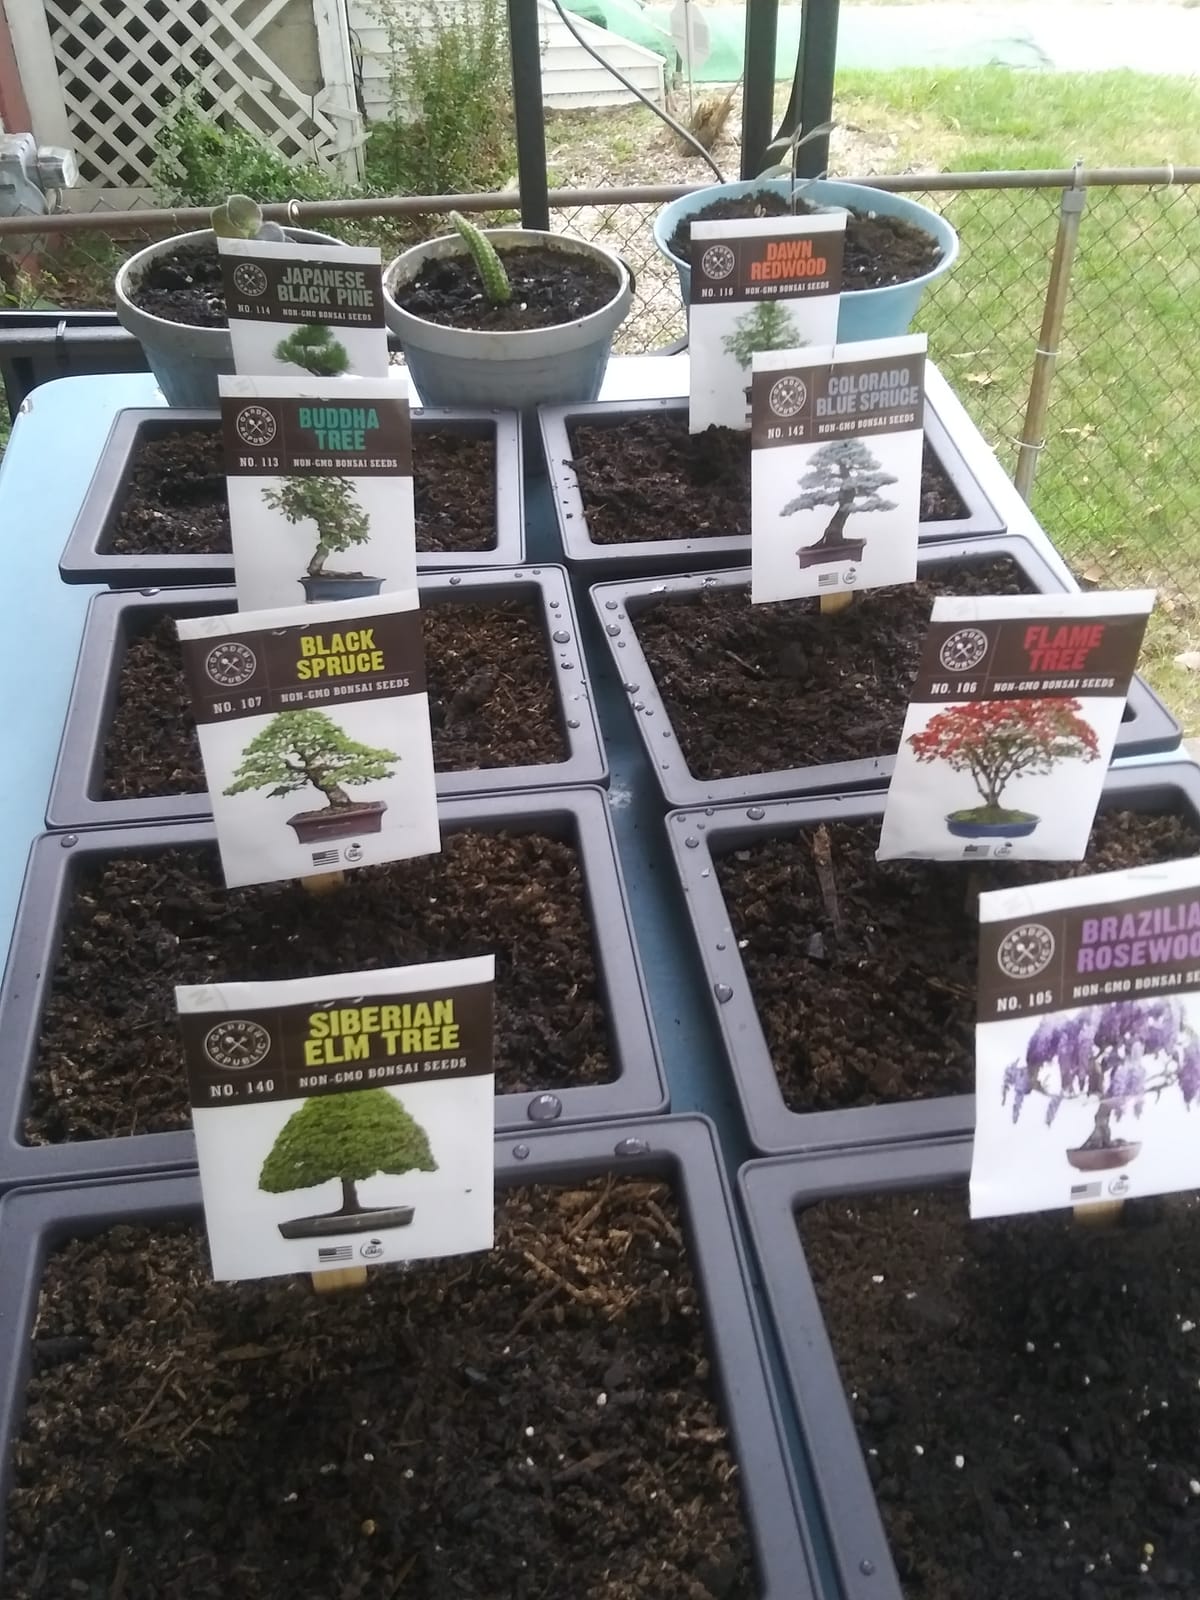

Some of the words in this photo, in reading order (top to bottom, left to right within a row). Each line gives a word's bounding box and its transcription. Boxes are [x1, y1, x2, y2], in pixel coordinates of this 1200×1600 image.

[767, 240, 813, 260] DAWN
[282, 267, 366, 289] JAPANESE
[751, 257, 826, 280] REDWOOD
[277, 284, 331, 304] BLACK
[337, 289, 374, 307] PINE
[702, 289, 716, 297] NO.
[720, 287, 733, 296] 116
[745, 285, 777, 295] NON-GMO
[780, 284, 805, 292] BONSAI
[807, 281, 829, 291] SEEDS
[238, 304, 252, 313] NO.
[257, 305, 270, 314] 114
[283, 308, 316, 318] NON-GMO
[319, 311, 346, 319] BONSAI
[349, 313, 372, 321] SEEDS
[828, 368, 909, 395] COLORADO
[817, 396, 857, 416] BLUE
[860, 386, 919, 410] SPRUCE
[240, 408, 270, 422] GARDEN
[299, 407, 379, 429] BUDDHA
[819, 421, 855, 433] NON-GMO
[858, 416, 887, 429] BONSAI
[889, 413, 915, 424] SEEDS
[240, 426, 273, 443] REPUBLIC
[315, 430, 366, 450] TREE
[768, 428, 783, 439] NO.
[788, 426, 804, 436] 142
[240, 458, 257, 467] NO.
[262, 457, 279, 467] 113
[293, 459, 333, 467] NON-GMO
[336, 459, 368, 468] BONSAI
[370, 459, 397, 468] SEEDS
[300, 629, 377, 657] BLACK
[948, 632, 983, 647] GARDEN
[1024, 624, 1105, 650] FLAME
[211, 646, 250, 663] GARDEN
[944, 650, 983, 669] REPUBLIC
[1029, 650, 1088, 672] TREE
[211, 662, 253, 683] REPUBLIC
[296, 651, 385, 680] SPRUCE
[281, 689, 331, 703] NON-GMO
[333, 683, 373, 696] BONSAI
[376, 678, 410, 691] SEEDS
[930, 683, 951, 694] NO.
[993, 681, 1039, 692] NON-GMO
[1042, 680, 1079, 689] BONSAI
[1082, 678, 1115, 689] SEEDS
[213, 702, 236, 714] NO.
[241, 697, 262, 709] 107
[1004, 929, 1047, 950] GARDEN
[1002, 949, 1049, 975] REPUBLIC
[1073, 979, 1131, 999] NON-GMO
[1135, 973, 1182, 991] BONSAI
[996, 997, 1022, 1012] NO.
[1029, 991, 1053, 1007] 105
[308, 999, 454, 1039] SIBERIAN
[210, 1023, 264, 1042] GARDEN
[210, 1041, 266, 1066] REPUBLIC
[304, 1034, 370, 1066] ELM
[381, 1024, 460, 1056] TREE
[300, 1070, 363, 1088] NON-GMO
[368, 1062, 419, 1079] BONSAI
[424, 1057, 467, 1072] SEEDS
[210, 1084, 239, 1098] NO.
[248, 1080, 275, 1093] 140
